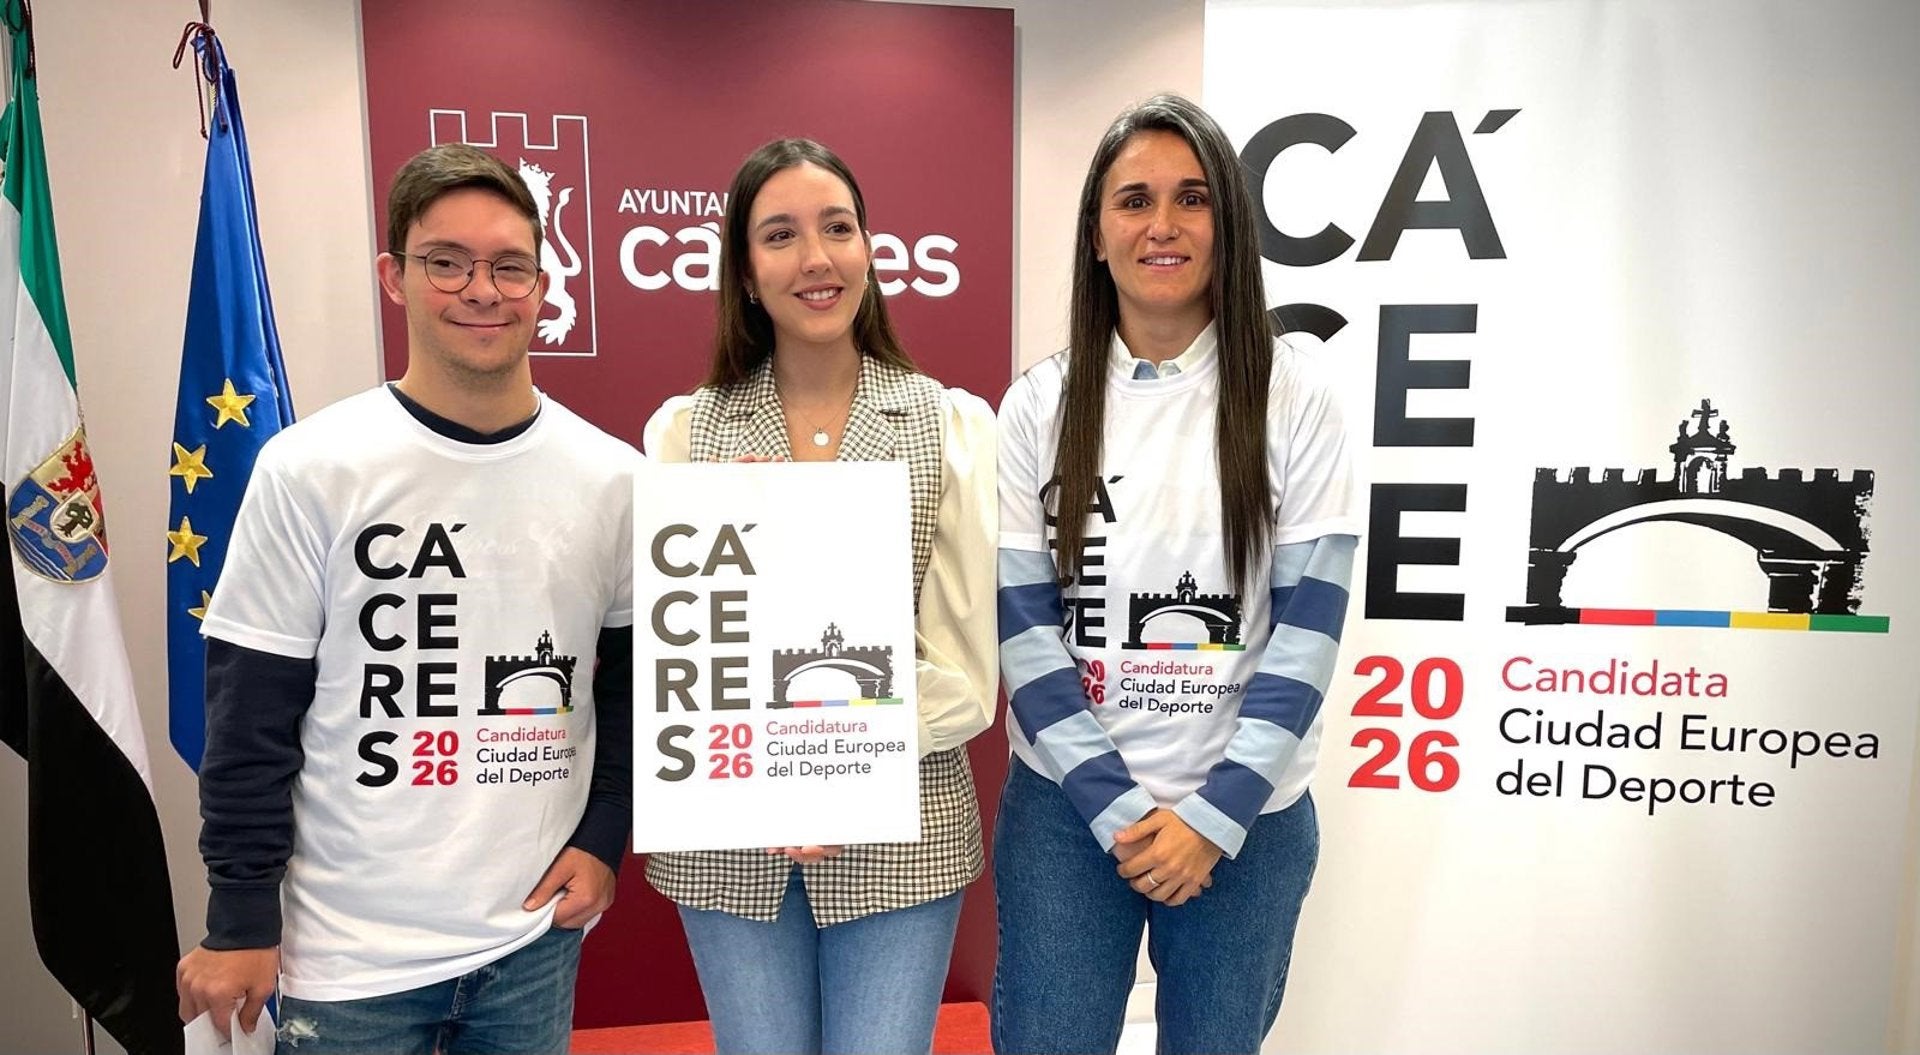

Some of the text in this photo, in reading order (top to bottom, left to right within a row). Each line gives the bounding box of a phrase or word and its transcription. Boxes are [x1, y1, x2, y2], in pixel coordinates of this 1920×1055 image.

[354, 522, 467, 580] CÁ
[651, 523, 757, 578] CÁ
[358, 593, 459, 651] CE
[651, 590, 750, 646] CE
[655, 656, 751, 712] RE
[1120, 660, 1214, 676] Candidatura
[1502, 656, 1728, 698] Candidata
[359, 662, 459, 718] RE
[1120, 678, 1240, 699] Ciudad Europea
[1350, 655, 1464, 720] 20
[1119, 696, 1214, 717] del Deporte
[412, 730, 459, 757] 20
[476, 726, 566, 742] Candidatura
[708, 723, 753, 750] 20
[766, 719, 868, 736] Candidatura
[1499, 707, 1879, 768] Ciudad Europea
[355, 731, 399, 787] S
[476, 746, 538, 763] Ciudad
[656, 724, 696, 782] S
[766, 738, 906, 758] Ciudad Europea
[1347, 727, 1460, 793] 26
[411, 759, 459, 786] 26
[476, 766, 570, 786] del Deporte
[708, 753, 753, 779] 26
[767, 760, 872, 780] del Deporte
[1496, 758, 1776, 815] del Deporte
